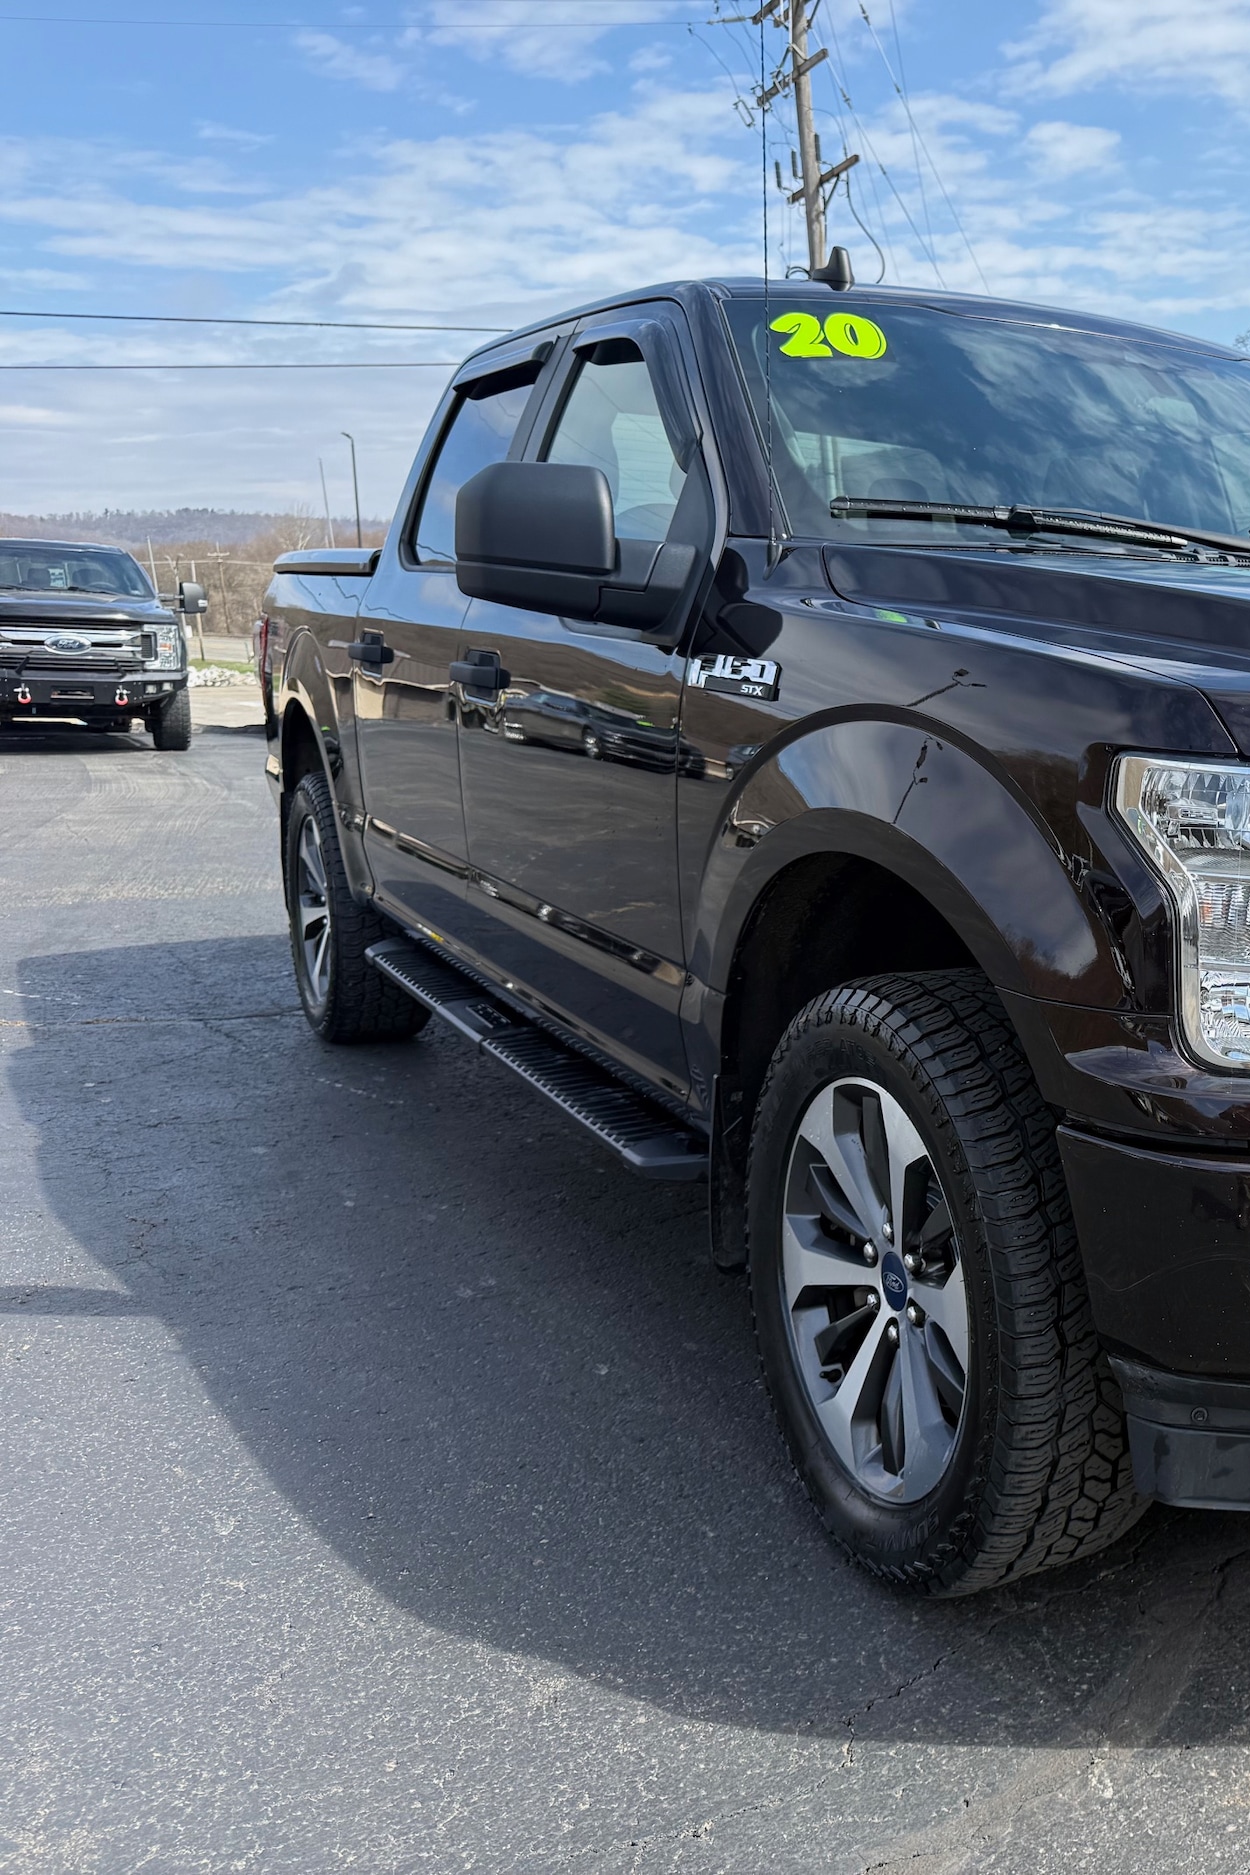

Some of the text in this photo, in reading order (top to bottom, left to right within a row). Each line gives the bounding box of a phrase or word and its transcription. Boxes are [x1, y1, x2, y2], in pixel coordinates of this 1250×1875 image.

[769, 312, 887, 359] 20
[56, 640, 80, 649] Ford
[740, 684, 763, 696] STX
